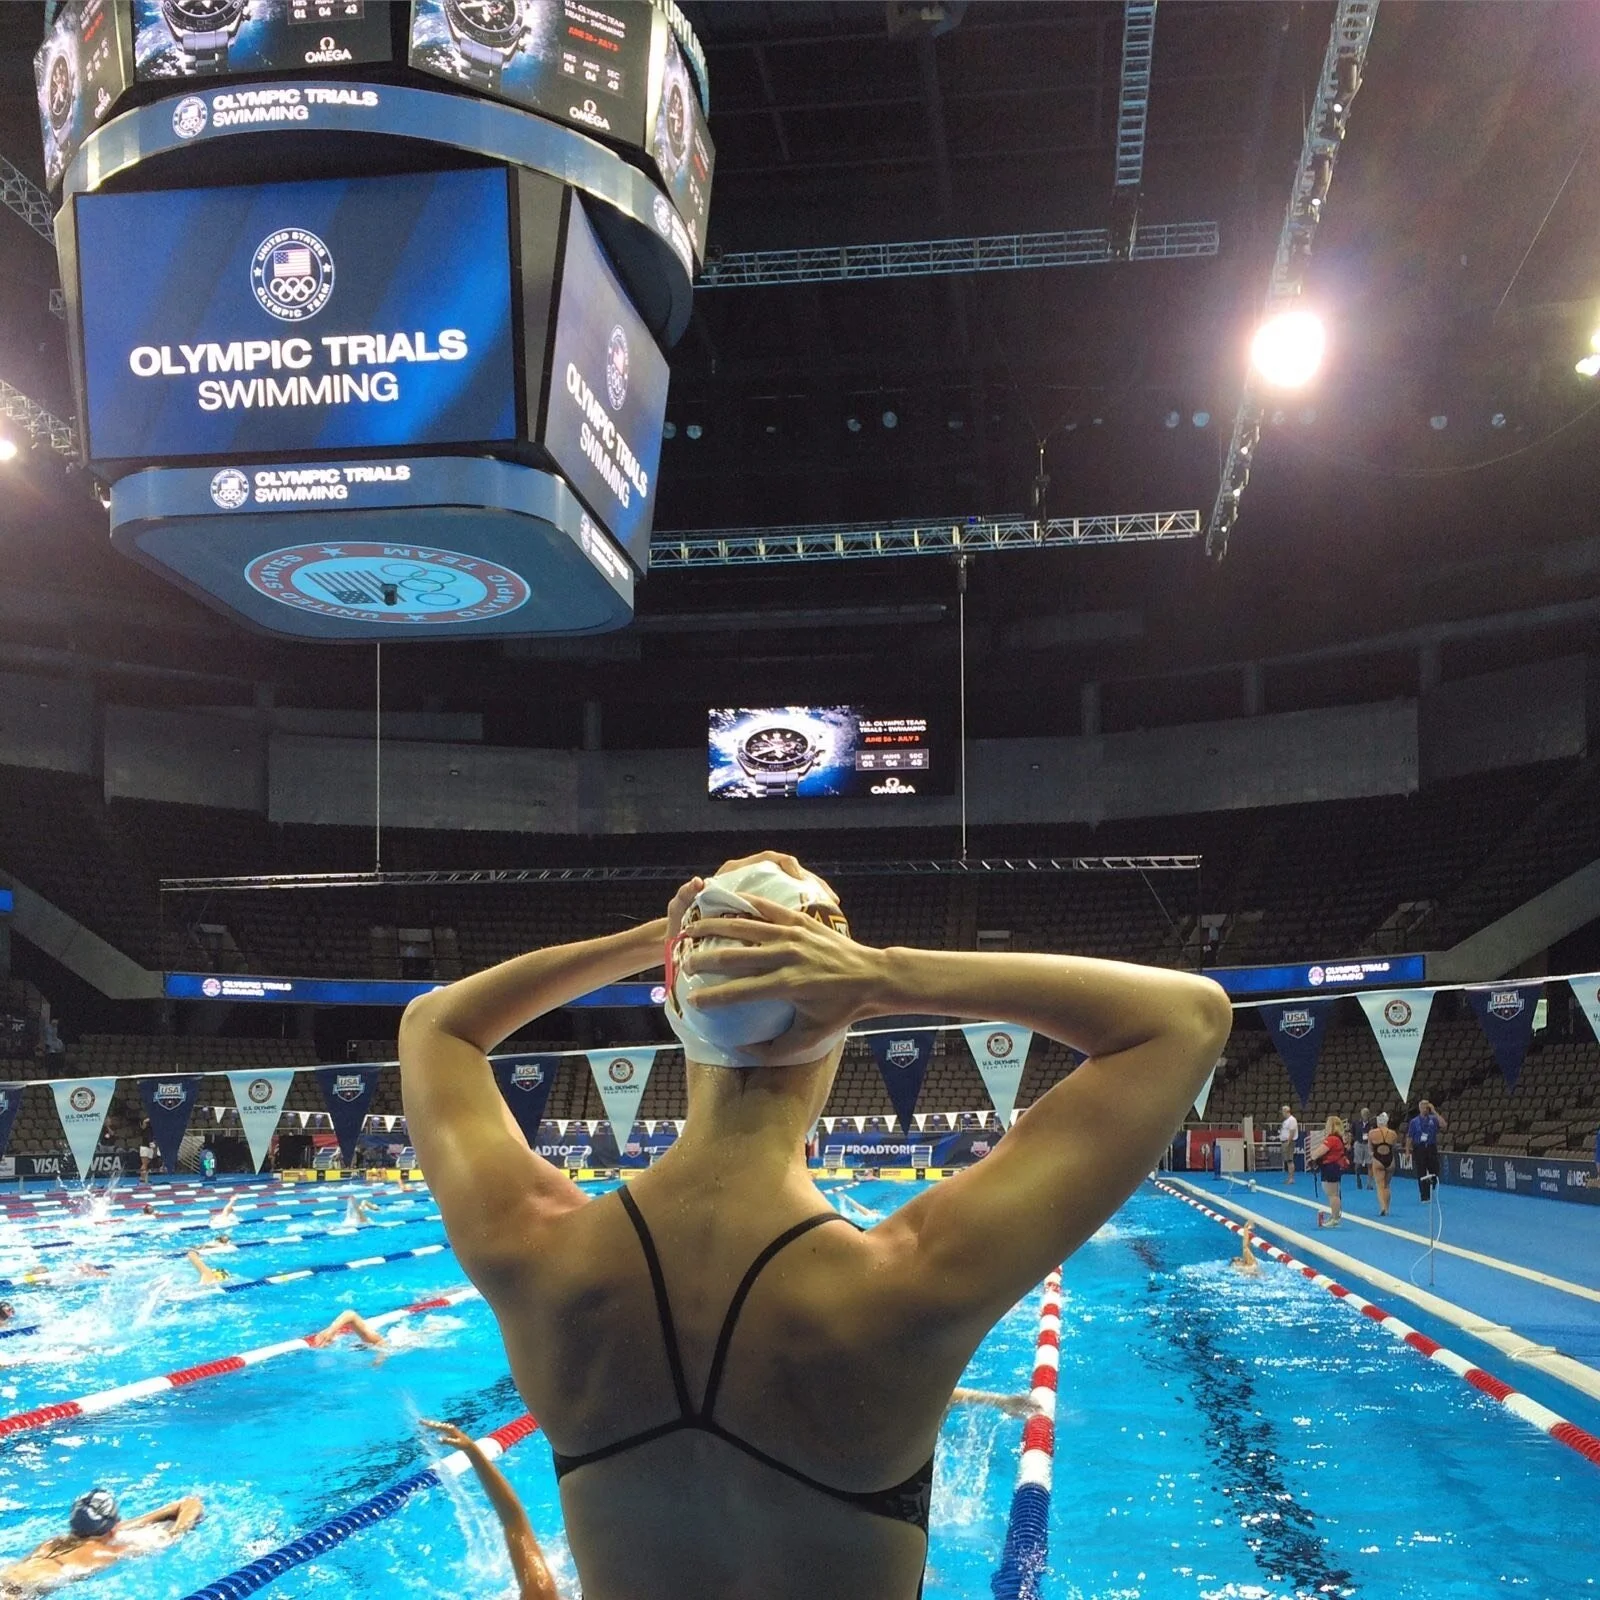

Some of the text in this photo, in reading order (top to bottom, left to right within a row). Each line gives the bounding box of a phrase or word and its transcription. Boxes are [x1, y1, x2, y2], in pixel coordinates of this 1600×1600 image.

[294, 4, 358, 19] 01 04 43
[304, 48, 352, 63] OMEGA
[564, 62, 618, 90] 01 04 43
[212, 88, 378, 111] OLYMPIC TRIALS
[212, 105, 308, 127] SWIMMING
[569, 106, 611, 130] OMEGA
[256, 232, 326, 261] UNITED STATES
[257, 283, 330, 318] OLYMPIC TEAM
[129, 330, 468, 376] OLYMPIC TRIALS
[198, 371, 399, 411] SWIMMING
[566, 362, 616, 450] OLYMPIC
[616, 432, 648, 498] TRIALS
[255, 465, 410, 487] OLYMPIC TRIALS
[580, 422, 630, 508] SWIMMING
[255, 484, 348, 503] SWIMMING
[260, 554, 304, 590] STATES
[384, 548, 514, 619] OLYMPIC TEAM
[870, 785, 916, 794] OMEGA
[1496, 994, 1516, 1003] USA
[162, 1086, 178, 1094] USA
[32, 1158, 60, 1174] VISA
[91, 1156, 122, 1172] VISA
